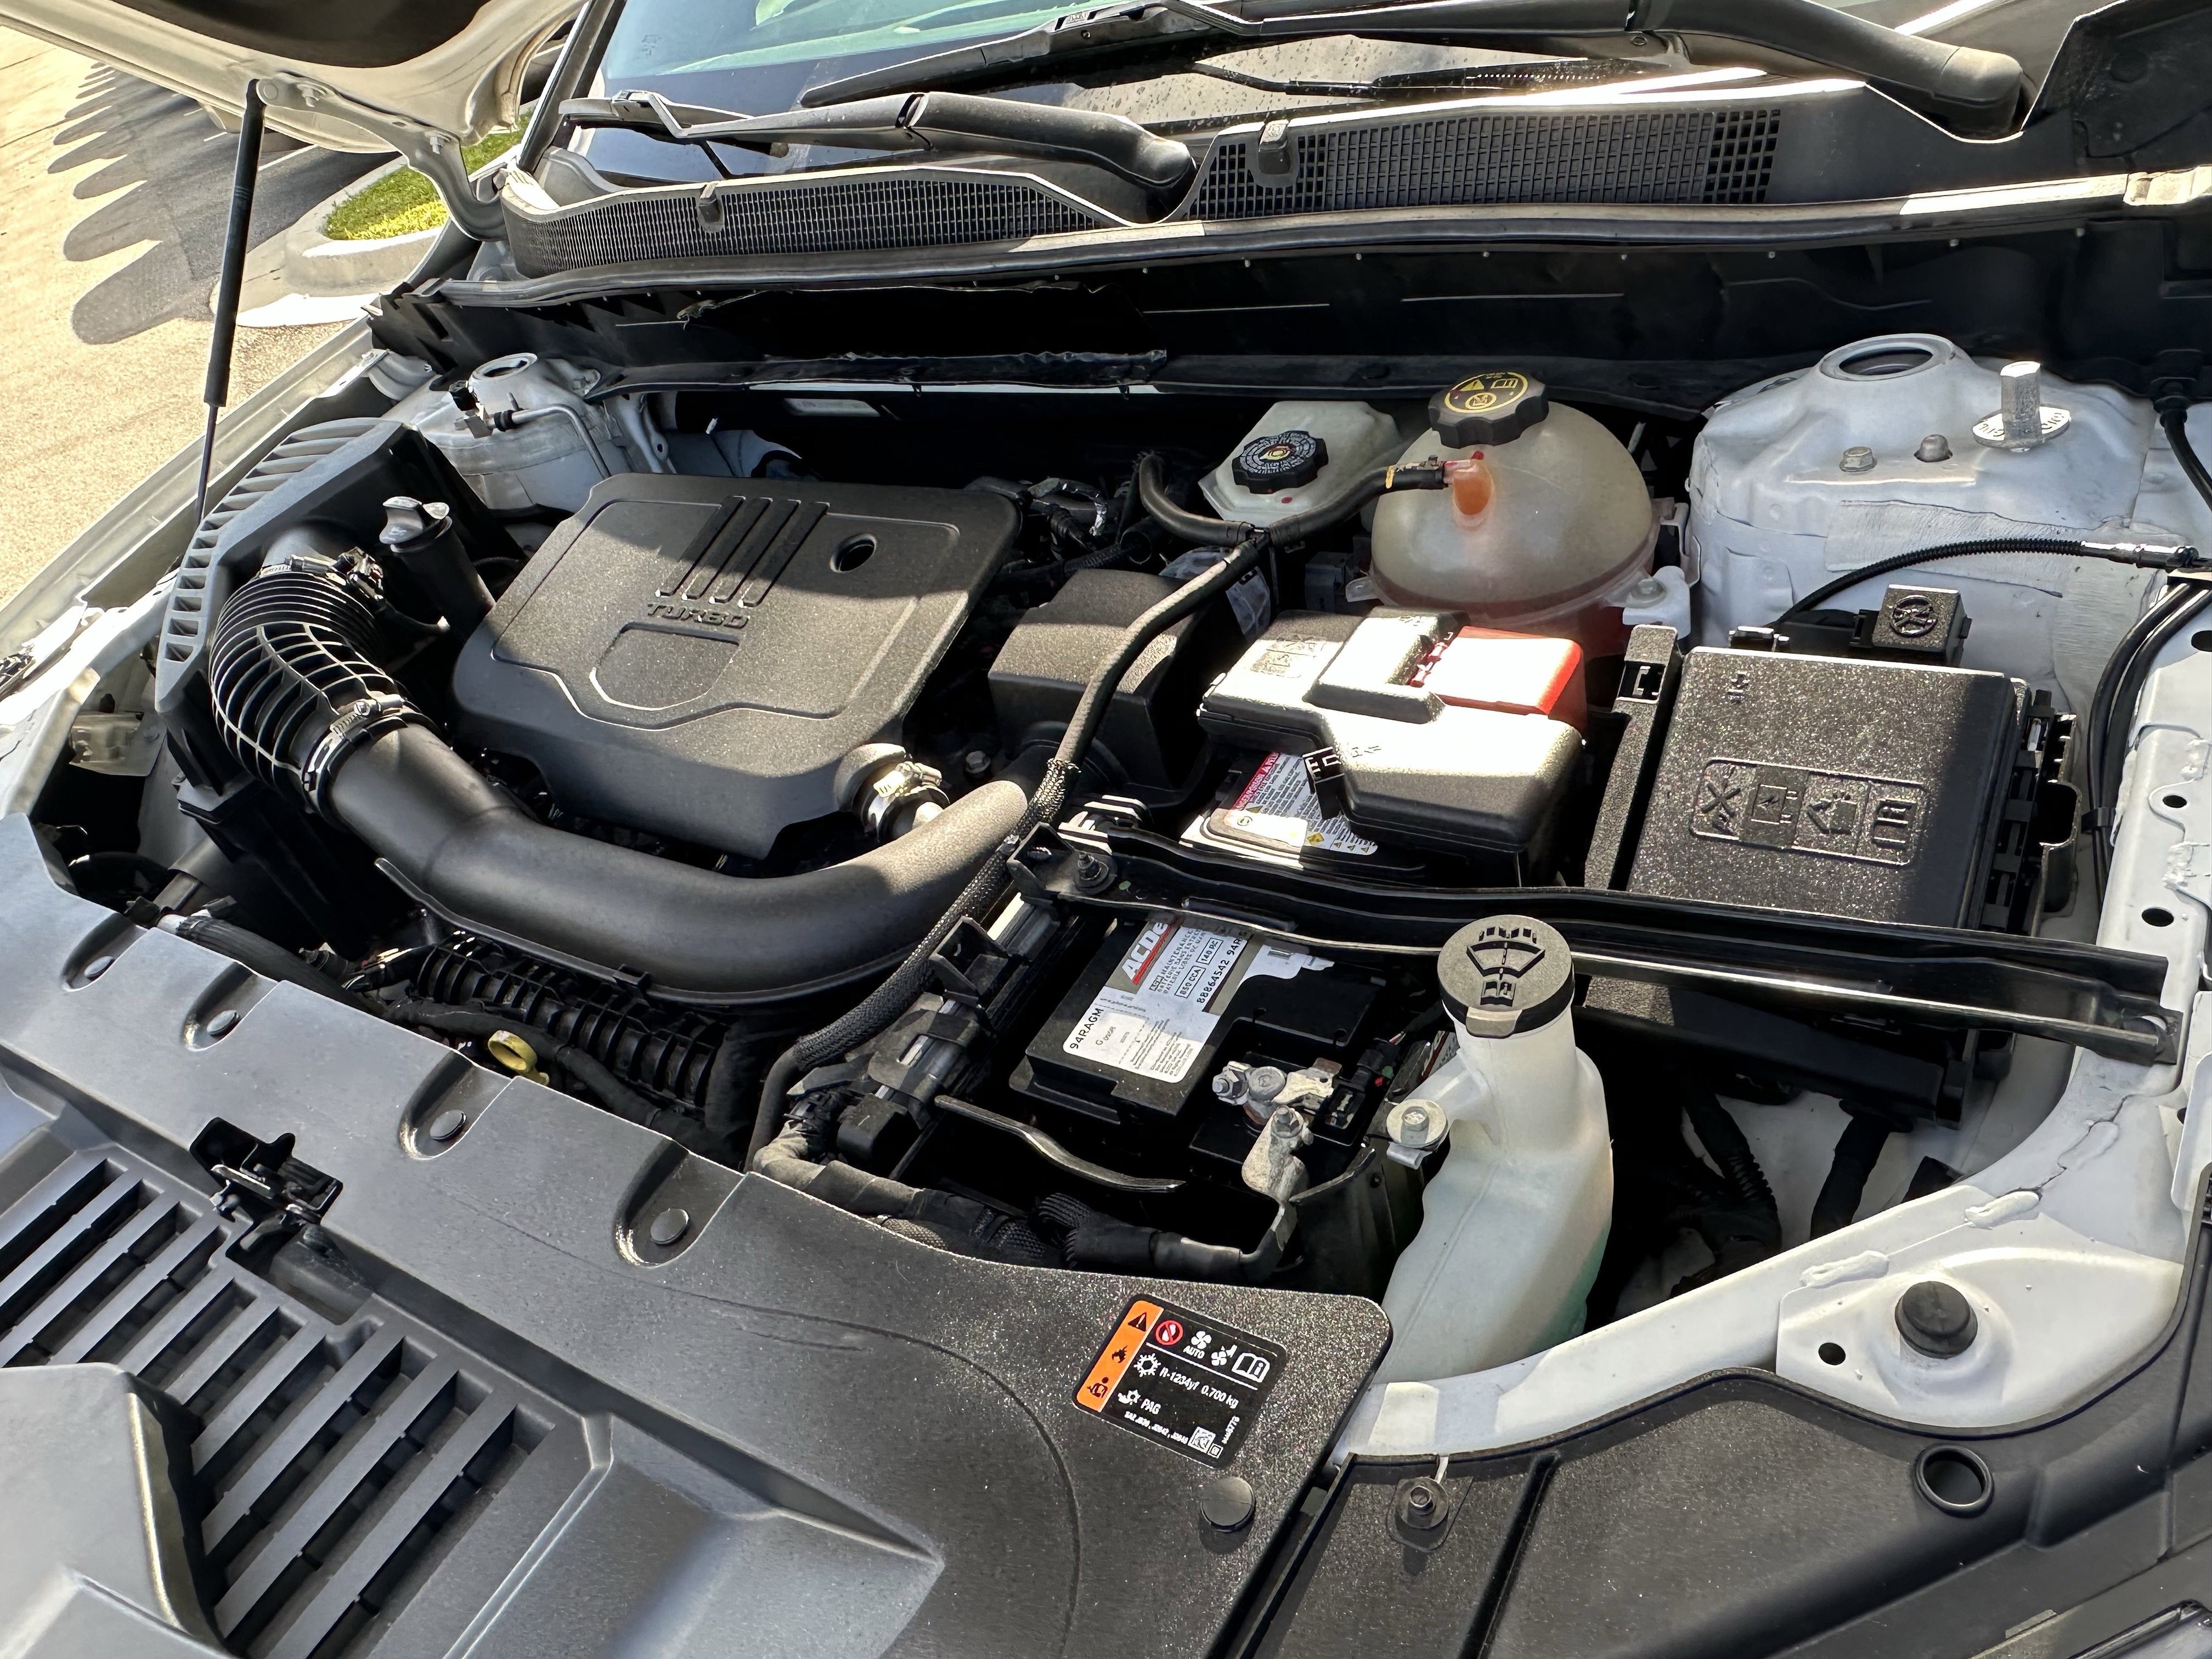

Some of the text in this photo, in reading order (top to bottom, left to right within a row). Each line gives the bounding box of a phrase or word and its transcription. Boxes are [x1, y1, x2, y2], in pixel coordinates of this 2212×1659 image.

[647, 603, 751, 629] TURBO
[1201, 949, 1212, 962] 140
[1181, 968, 1201, 995] 850 CCA
[1197, 959, 1230, 1003] 88864542
[1070, 1008, 1104, 1049] 94RAGM
[1183, 1345, 1205, 1359] AUTO
[1159, 1368, 1239, 1409] R-1234yf 0.700 kg
[1141, 1399, 1161, 1414] PAG
